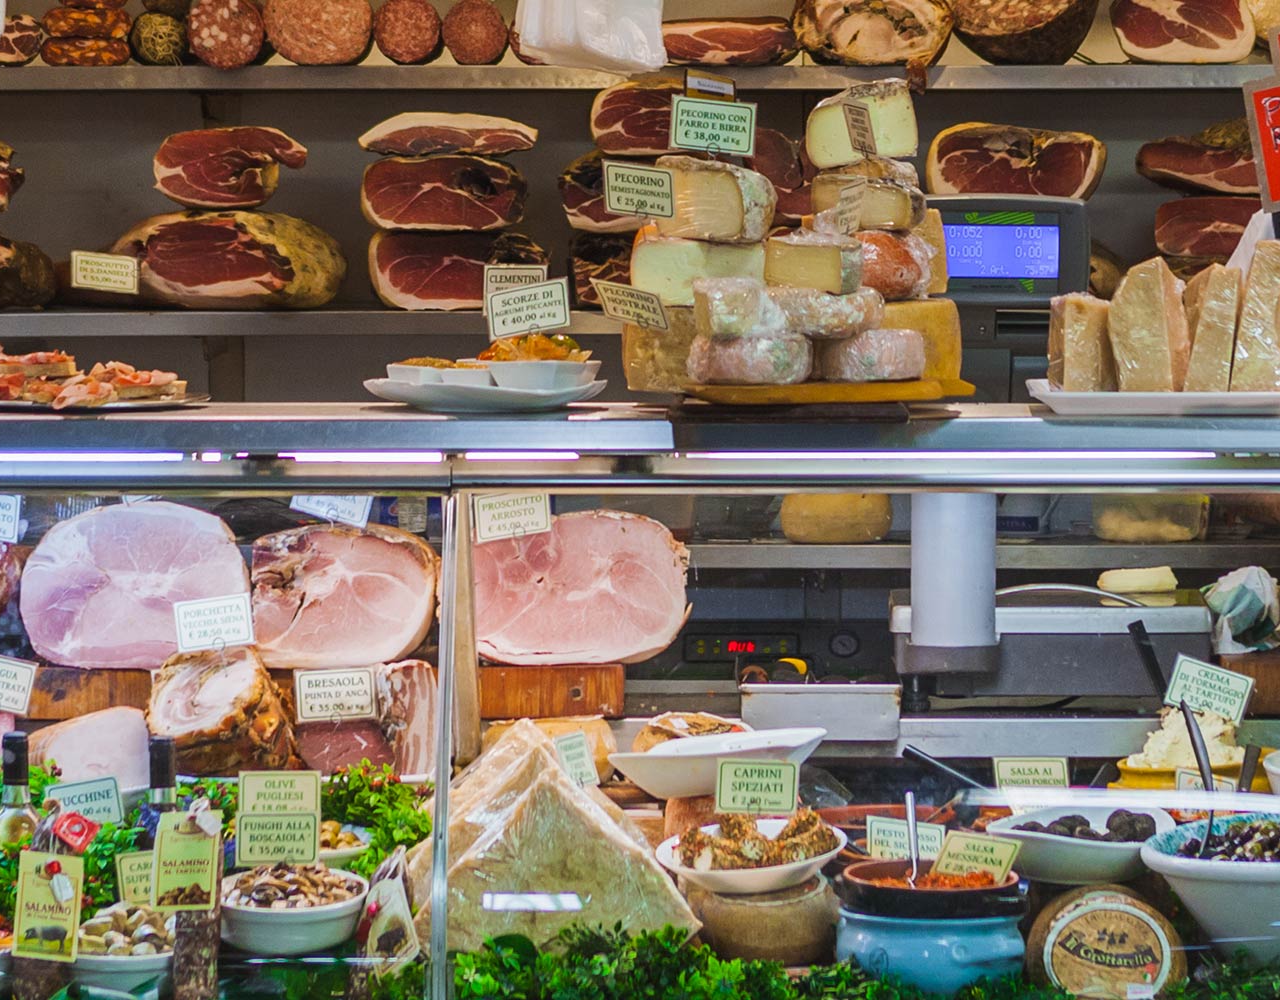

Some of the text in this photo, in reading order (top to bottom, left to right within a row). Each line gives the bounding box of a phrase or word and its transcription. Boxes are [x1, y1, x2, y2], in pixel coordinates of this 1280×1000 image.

[680, 108, 747, 124] PECORINO CON
[679, 118, 747, 134] FARRO E BIRRA
[684, 129, 690, 139] €
[693, 130, 721, 143] 38,00
[614, 172, 664, 188] PECORINO
[610, 185, 670, 200] SEMISTAGIONATO
[617, 196, 648, 208] € 25,00
[80, 259, 129, 270] PROSCIUTTO
[489, 275, 541, 284] CLEMENTINI
[501, 290, 554, 308] SCORZE DI
[602, 286, 655, 305] PECORINO
[494, 299, 562, 318] AGRUMI PICCANTE
[606, 295, 658, 315] NOSTRALE
[502, 313, 537, 327] € 40,00
[481, 496, 543, 512] PROSCIUTTO
[490, 507, 535, 522] ARROSTO
[183, 603, 242, 620] PORCHETTA
[307, 677, 364, 689] BRESAOLA
[1198, 669, 1230, 685] CREMA
[1179, 672, 1244, 699] DI FORMAGGIO
[304, 689, 368, 700] PUNTA ANCA
[1182, 684, 1235, 706] AL TARTUFO
[734, 768, 782, 779] CAPRINI
[1010, 767, 1052, 776] SALSA AI
[264, 779, 296, 789] OLIVE
[731, 781, 783, 793] SPEZIATI
[62, 789, 113, 807] UCCHINE
[256, 791, 304, 801] PUGLIESI
[244, 821, 311, 831] FUNGHI ALLA
[249, 834, 305, 843] BOSCAIOLA
[876, 828, 905, 839] PESTO
[874, 838, 890, 847] DEL
[964, 842, 994, 854] SALSA
[162, 859, 210, 868] SALAMINO
[947, 851, 1002, 867] MESSICANA
[25, 902, 72, 915] SALAMINO
